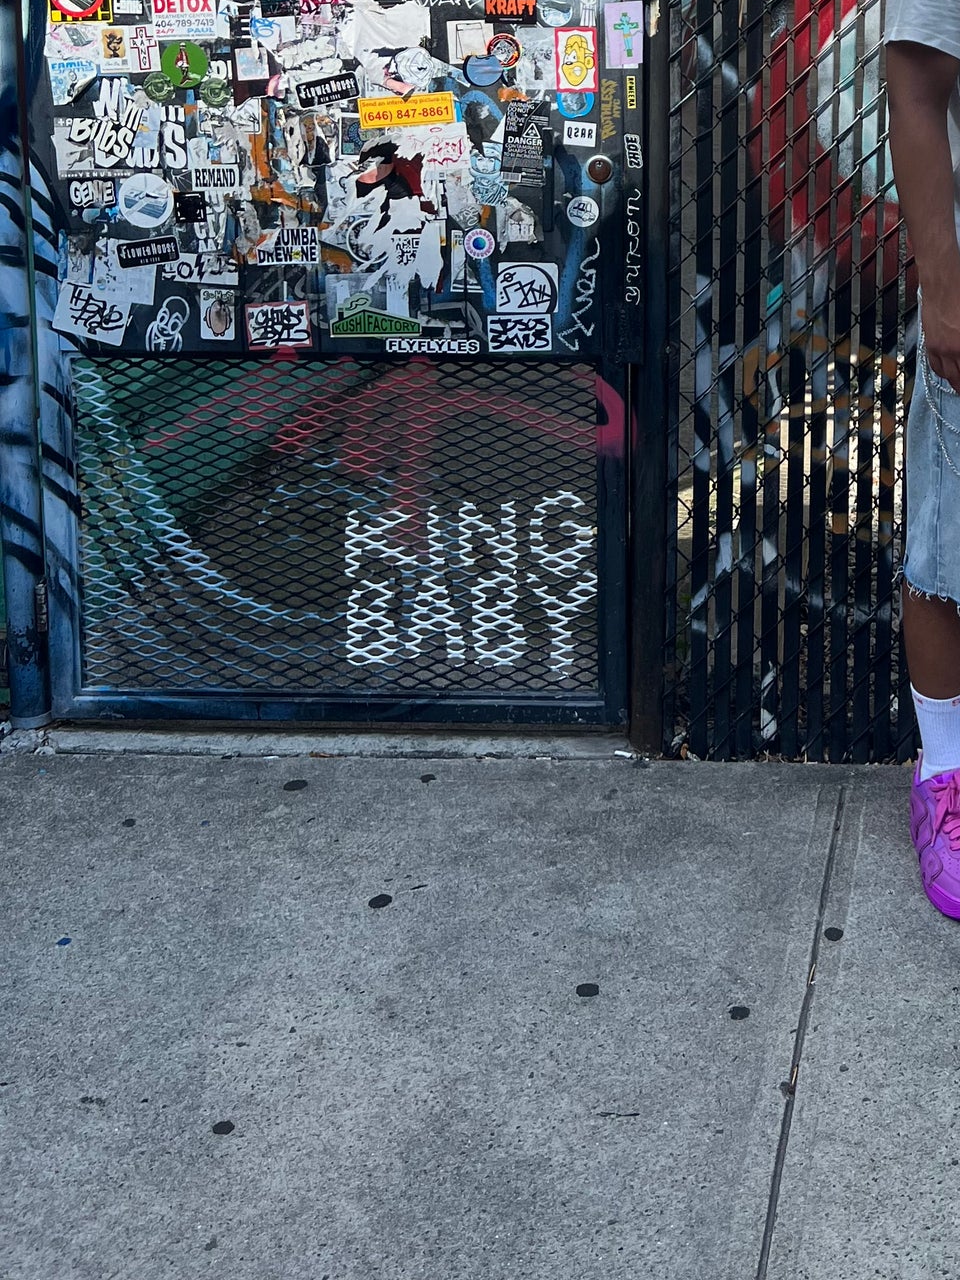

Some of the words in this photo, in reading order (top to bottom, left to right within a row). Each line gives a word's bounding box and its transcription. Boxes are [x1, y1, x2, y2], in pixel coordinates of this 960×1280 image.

[155, 19, 215, 28] 404-789-7419
[363, 111, 393, 123] (646)
[396, 106, 449, 119] 847-8861
[507, 136, 543, 146] DANGER
[194, 168, 236, 188] REMAND
[334, 319, 363, 333] KUSH
[367, 315, 417, 333] FACTORY
[388, 339, 479, 352] FLYFLYLES
